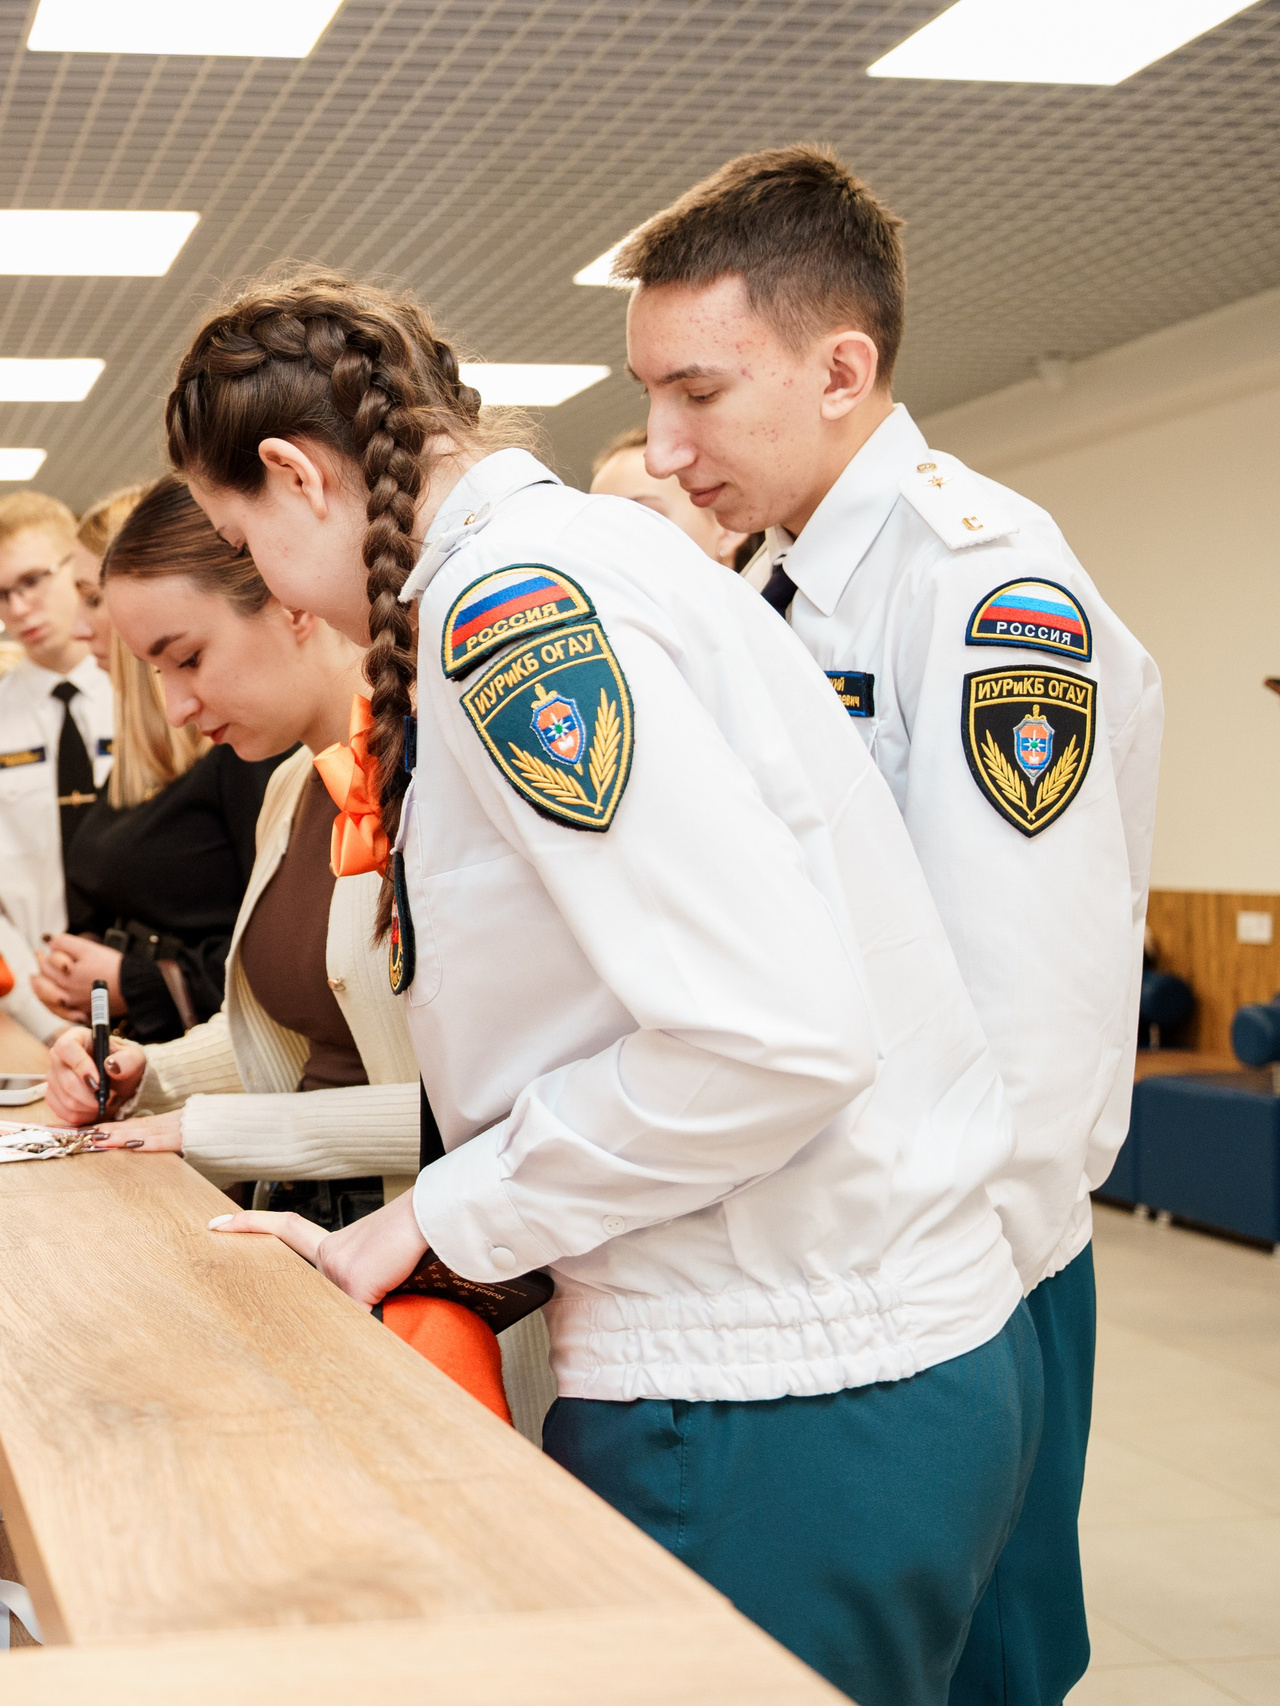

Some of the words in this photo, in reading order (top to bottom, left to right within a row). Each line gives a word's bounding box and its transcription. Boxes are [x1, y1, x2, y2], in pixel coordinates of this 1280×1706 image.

[465, 602, 560, 653] РОССИЯ
[995, 621, 1072, 646] РОССИЯ
[474, 652, 540, 716] ИУРиКБ
[540, 632, 595, 665] ОГАУ
[977, 677, 1045, 700] ИУРиКБ
[1048, 679, 1088, 705] ОГАУ
